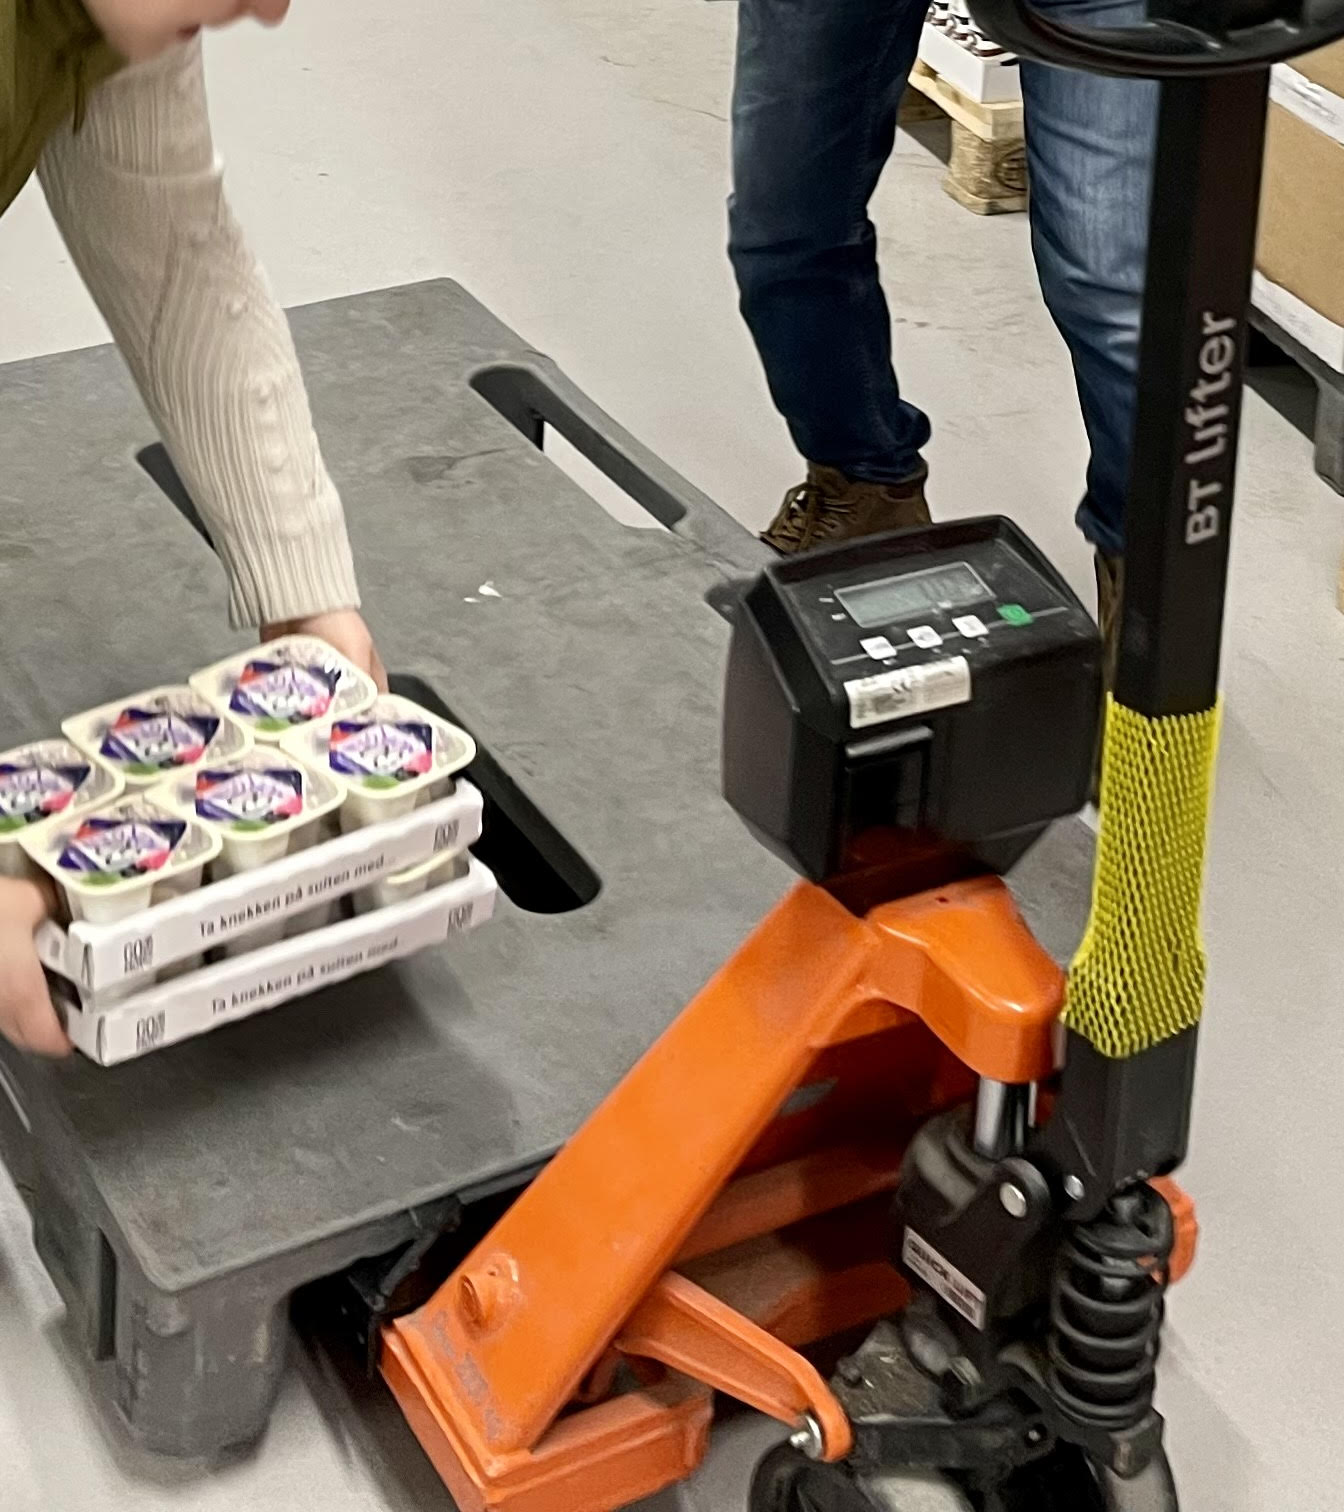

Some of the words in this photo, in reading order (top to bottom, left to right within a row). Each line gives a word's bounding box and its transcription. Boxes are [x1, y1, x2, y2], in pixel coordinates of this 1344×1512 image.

[1184, 311, 1238, 464] Lifter
[1185, 479, 1223, 545] BT
[200, 921, 215, 937] Ta
[220, 894, 281, 931] knekken
[284, 885, 303, 907] på
[230, 975, 292, 1009] knekken
[296, 965, 315, 986] på
